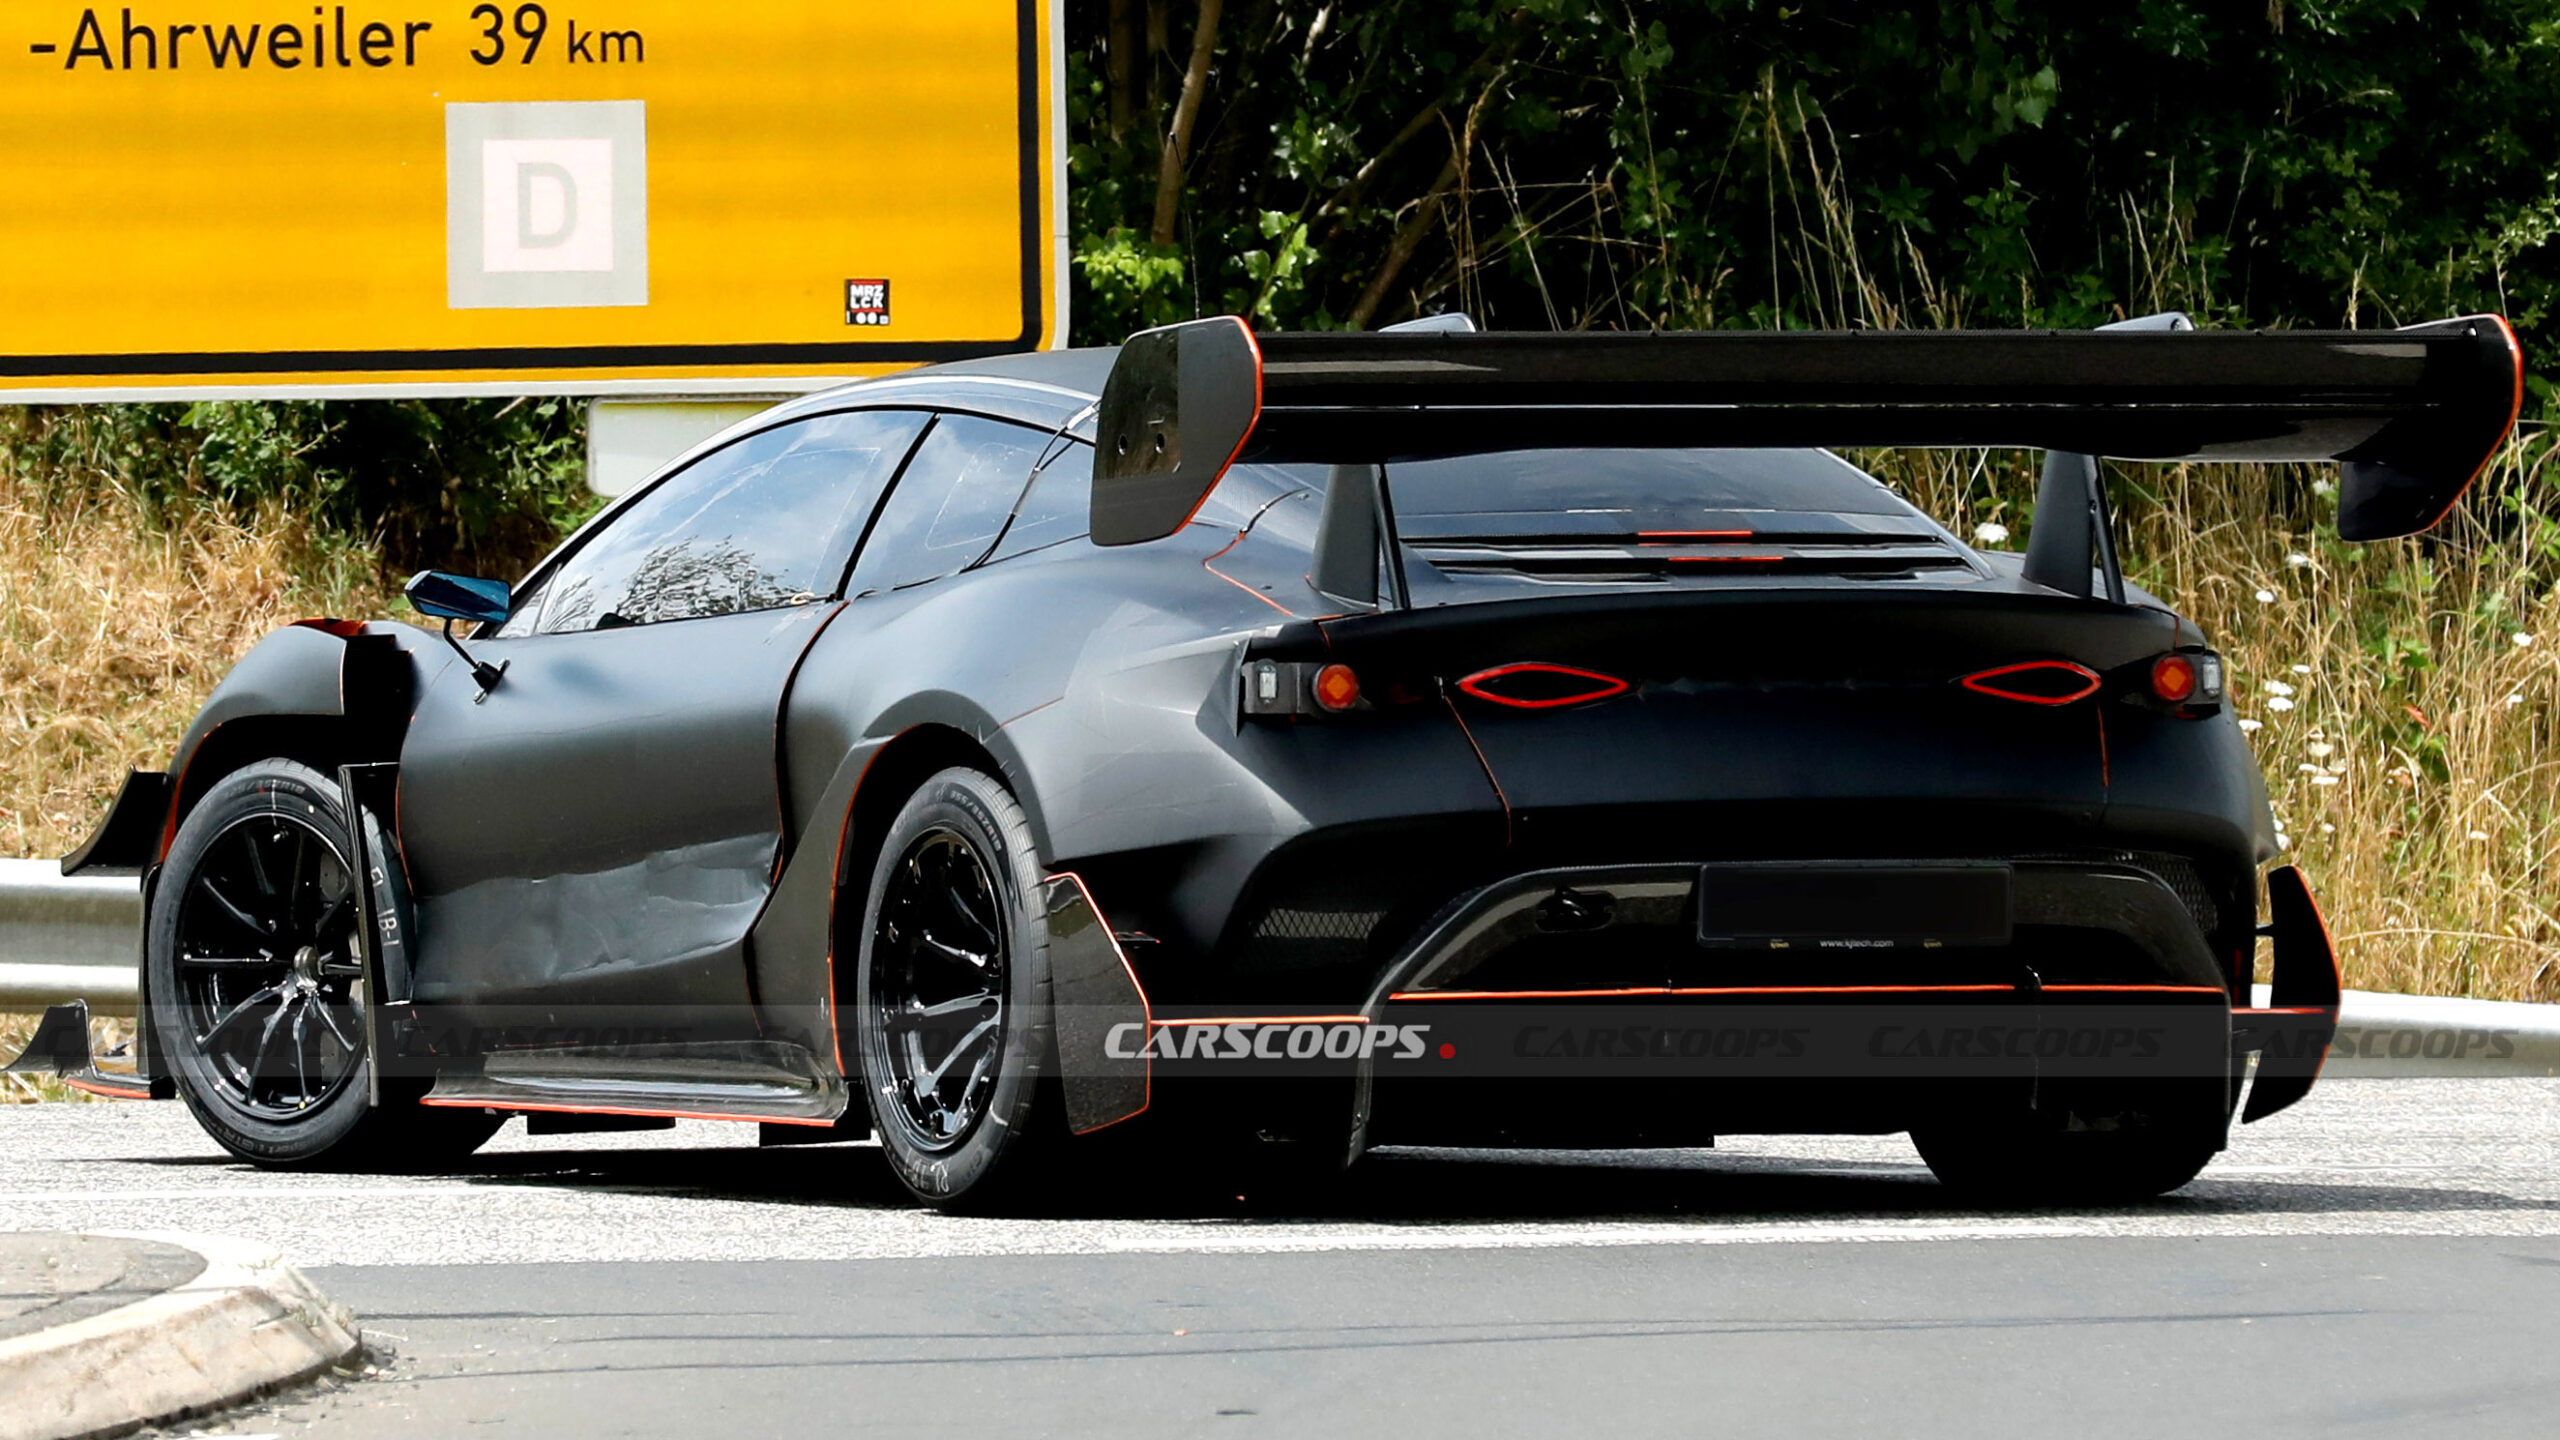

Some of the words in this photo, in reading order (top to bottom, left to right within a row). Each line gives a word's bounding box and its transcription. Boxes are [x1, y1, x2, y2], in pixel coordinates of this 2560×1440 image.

[29, 5, 433, 70] -Ahrweiler
[469, 2, 549, 66] 39
[567, 19, 645, 64] km
[516, 161, 578, 249] D
[850, 284, 884, 297] MRZ
[850, 296, 884, 309] LCK
